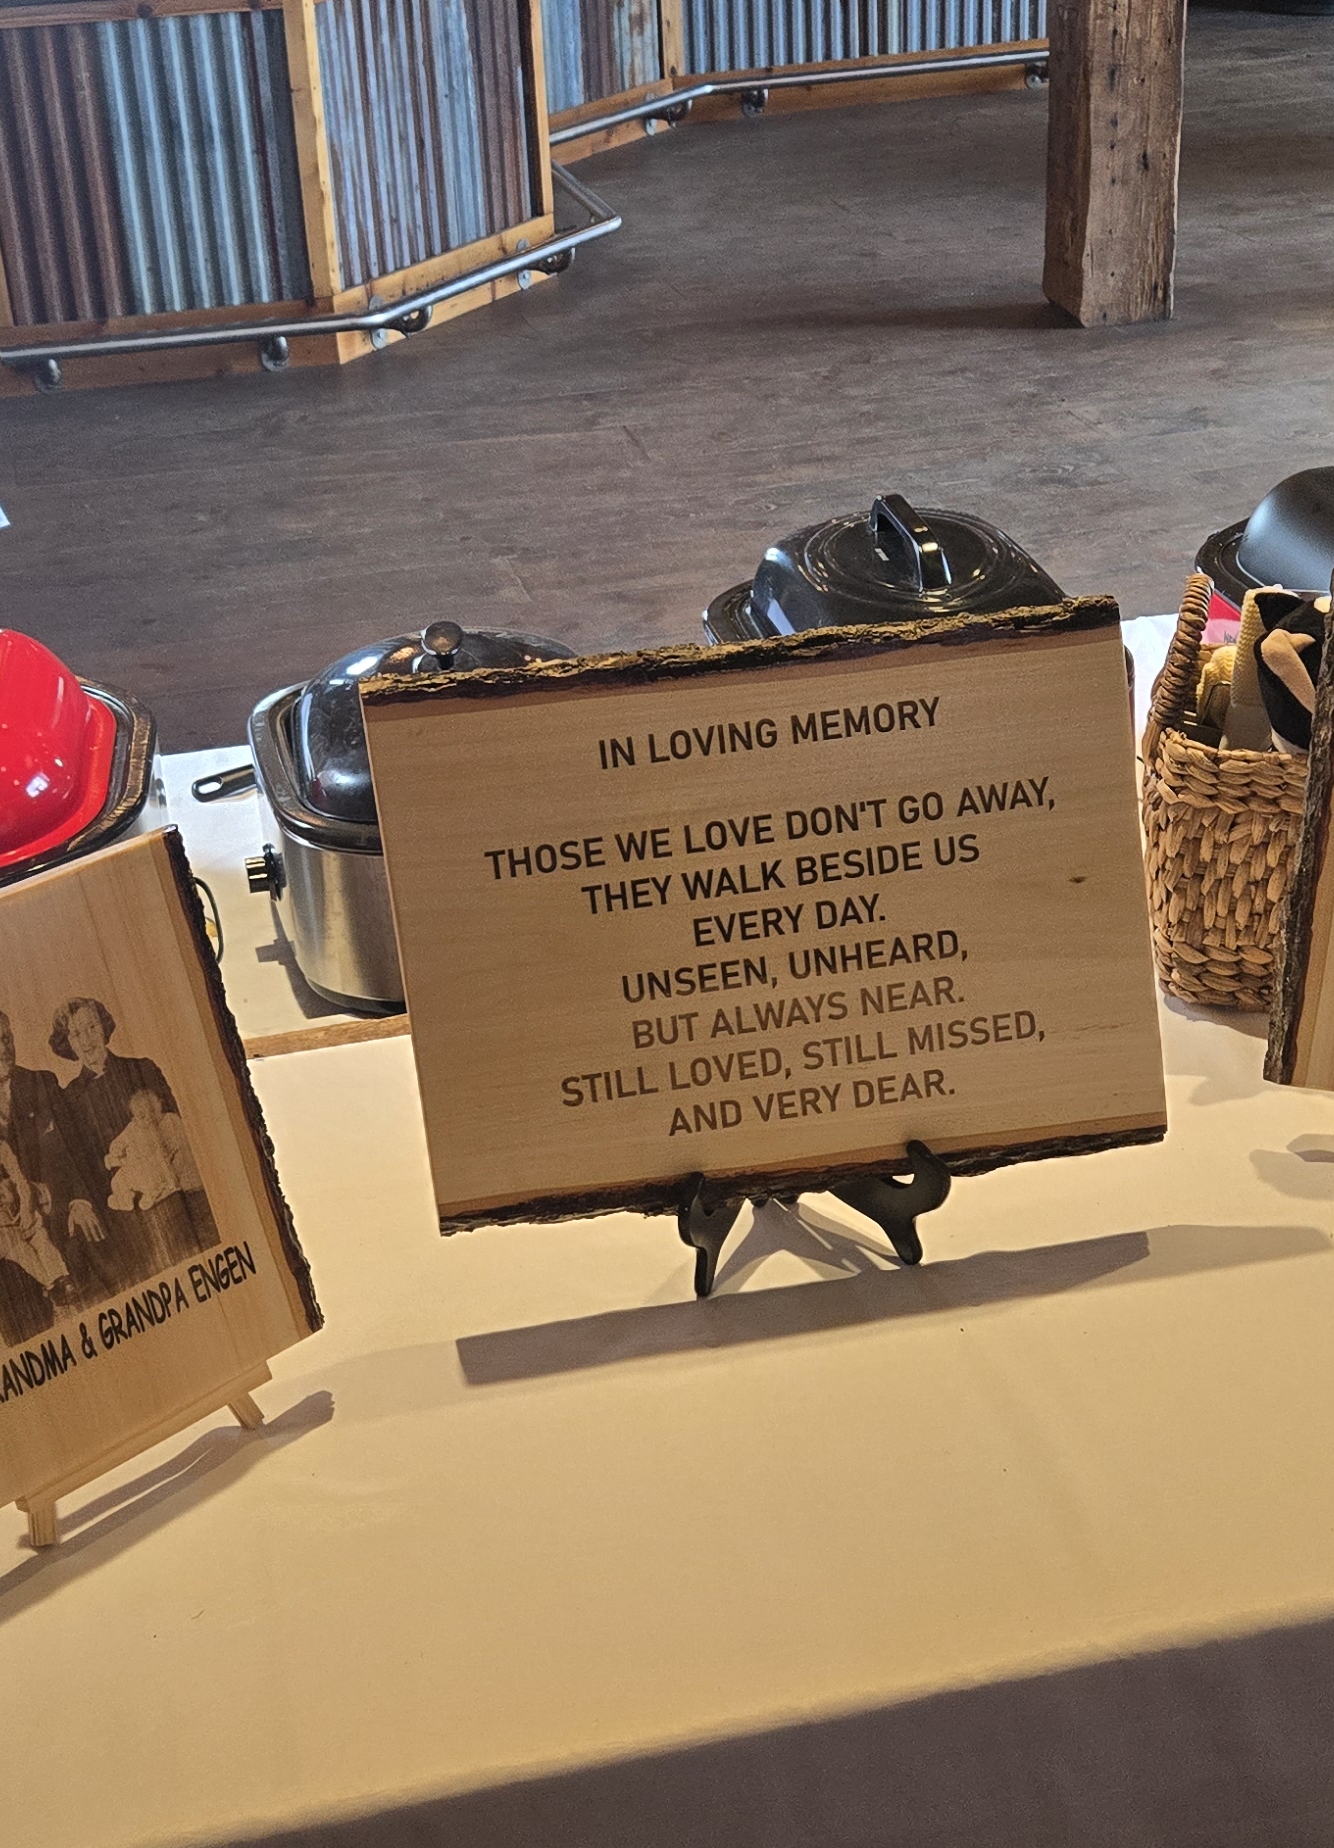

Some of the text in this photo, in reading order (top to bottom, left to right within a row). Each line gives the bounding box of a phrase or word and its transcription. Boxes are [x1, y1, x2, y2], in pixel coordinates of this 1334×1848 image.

[598, 696, 940, 770] IN LOVING MEMORY
[485, 776, 1056, 880] THOSE WE LOVE DON'T GO AWAY,
[582, 833, 980, 915] THEY WALK BESIDE US
[693, 893, 887, 947] EVERY DAY.
[621, 929, 969, 1004] UNSEEN, UNHEARD,
[632, 975, 965, 1050] BUT ALWAYS NEAR.
[561, 1009, 1046, 1107] STILL LOVED, STILL MISSED,
[668, 1067, 956, 1136] AND VERY DEAR.
[79, 1322, 98, 1359] &
[98, 1277, 190, 1350] GRANDPA
[187, 1240, 257, 1303] ENGEN
